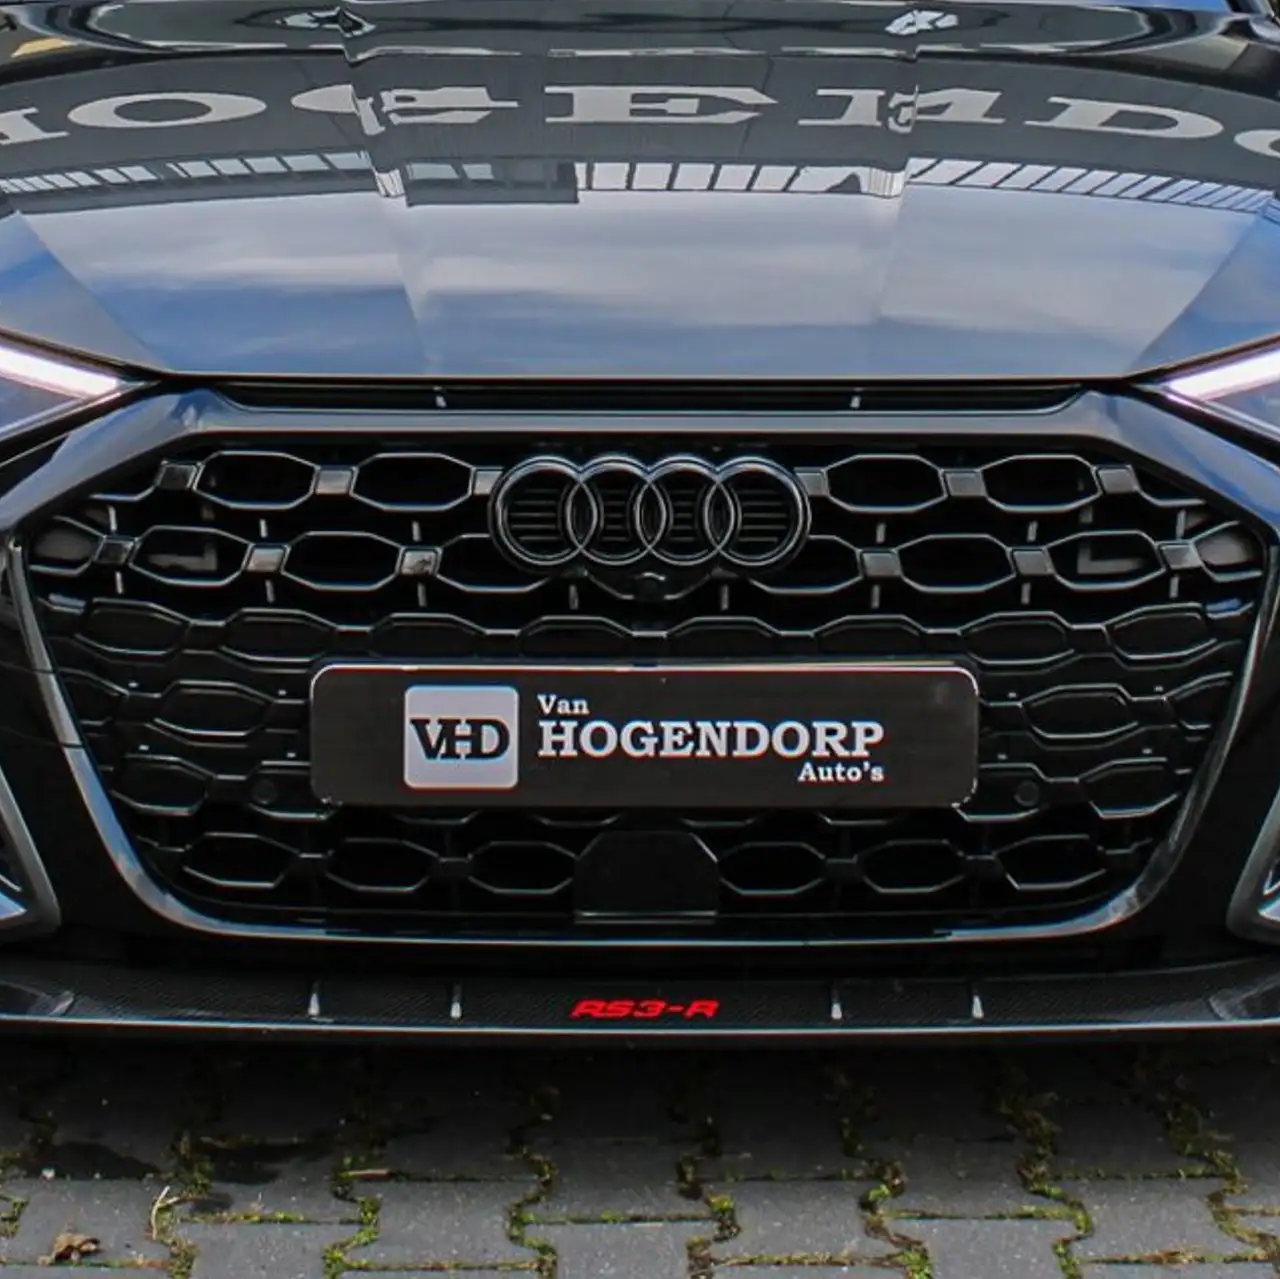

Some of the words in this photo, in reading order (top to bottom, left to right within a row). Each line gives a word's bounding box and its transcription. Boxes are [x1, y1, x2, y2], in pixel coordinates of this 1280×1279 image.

[536, 693, 590, 715] Van
[409, 718, 512, 761] VHD
[537, 719, 885, 759] HOGENDORP
[797, 761, 885, 783] Auto's
[570, 998, 720, 1019] RS3-R
